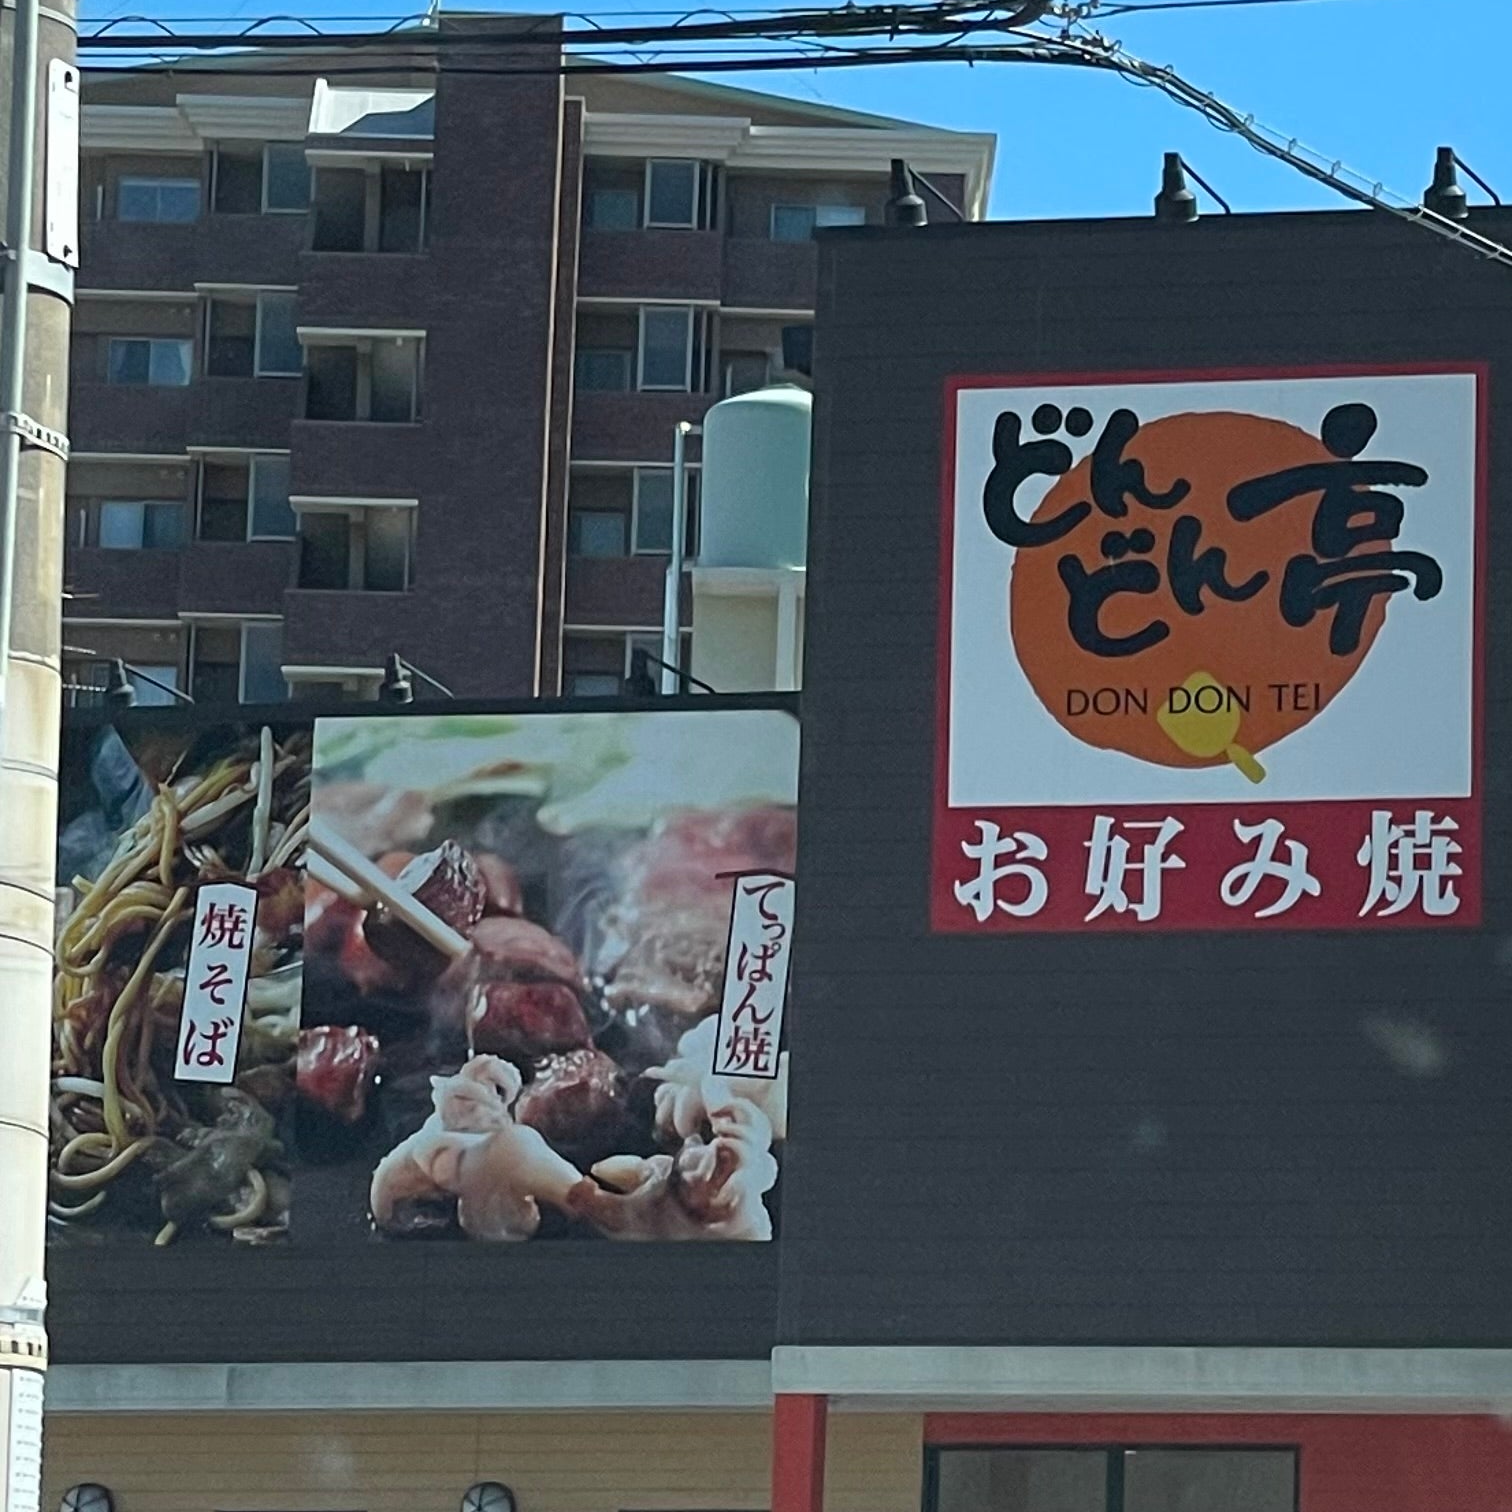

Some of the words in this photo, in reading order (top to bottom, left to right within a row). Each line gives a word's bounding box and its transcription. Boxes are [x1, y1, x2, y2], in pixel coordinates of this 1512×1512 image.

[1066, 687, 1149, 716] DON
[1168, 684, 1250, 714] DON
[1271, 682, 1321, 712] TEI
[954, 809, 1463, 922] お好み焼
[183, 902, 248, 1066] 焼そば
[723, 881, 786, 1072] てっぱん焼
